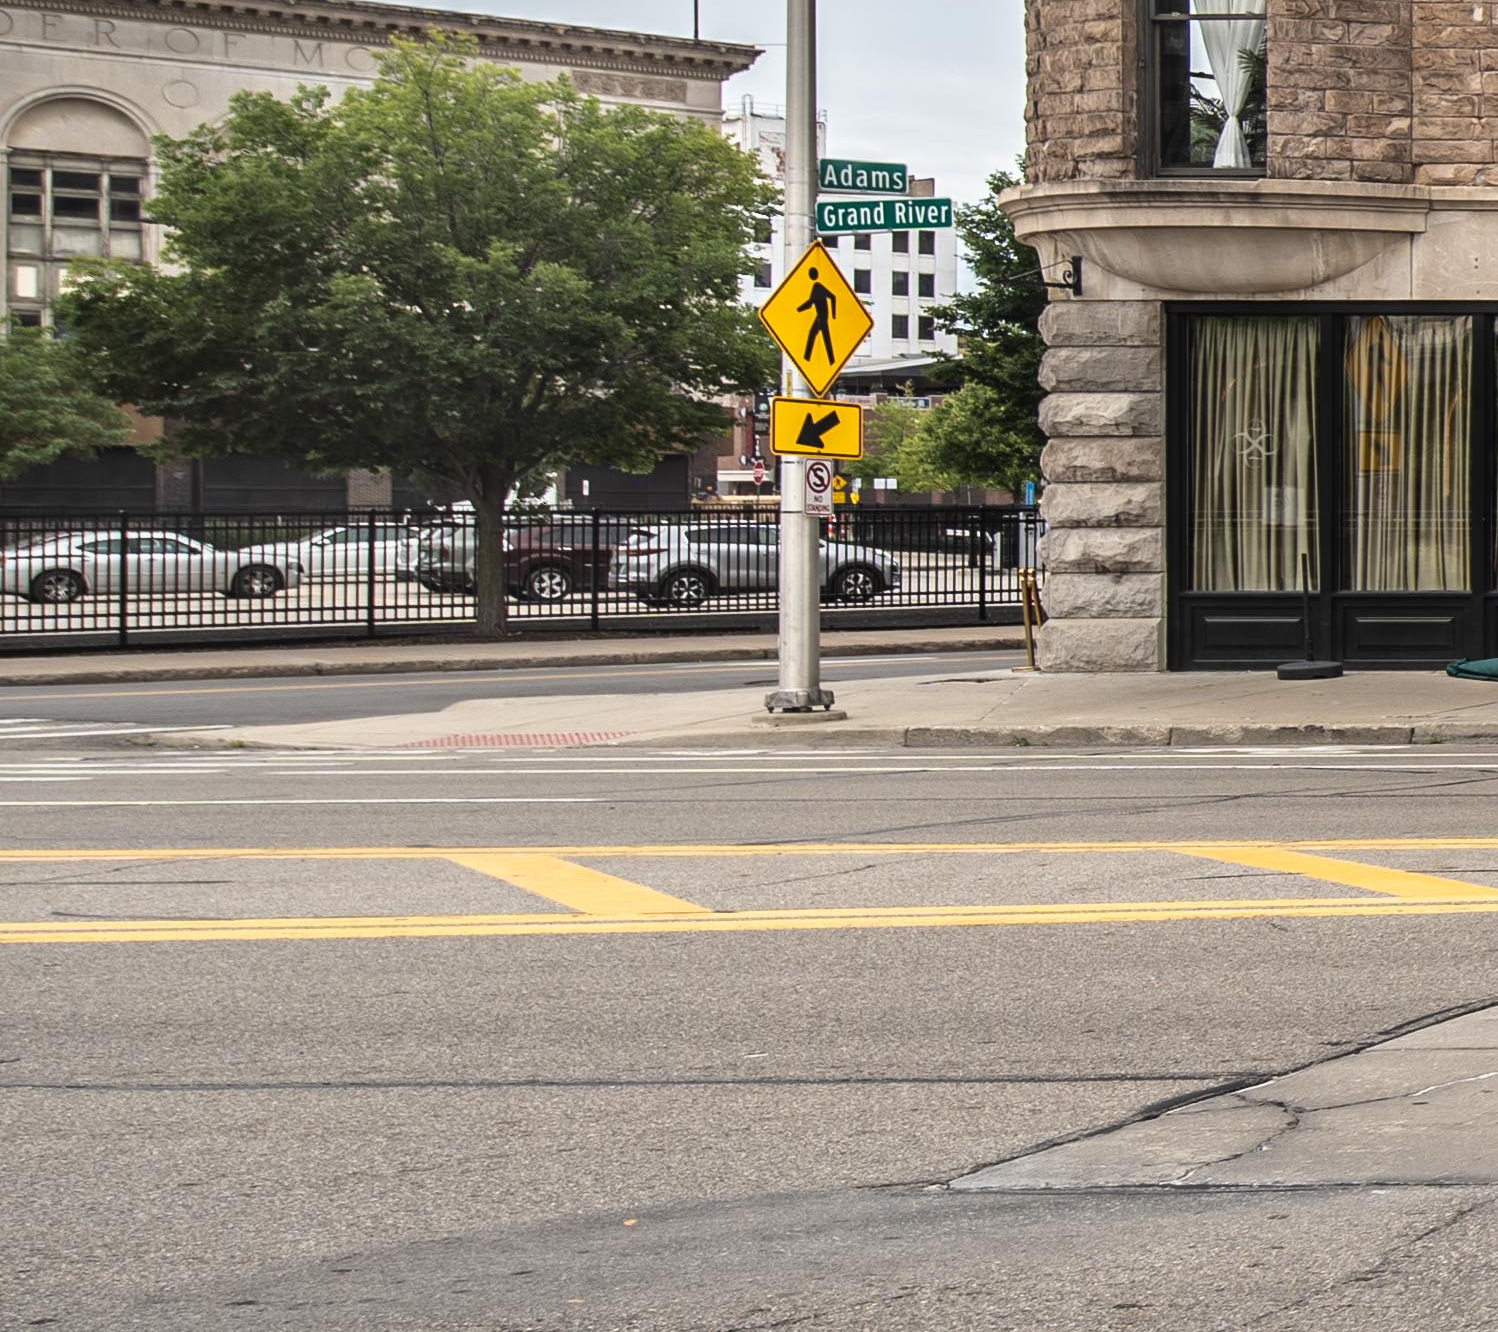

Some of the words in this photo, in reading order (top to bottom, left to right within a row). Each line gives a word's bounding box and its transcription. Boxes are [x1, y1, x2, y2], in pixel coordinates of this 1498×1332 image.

[823, 163, 904, 190] Adams
[823, 201, 885, 227] Grand
[894, 200, 949, 225] River
